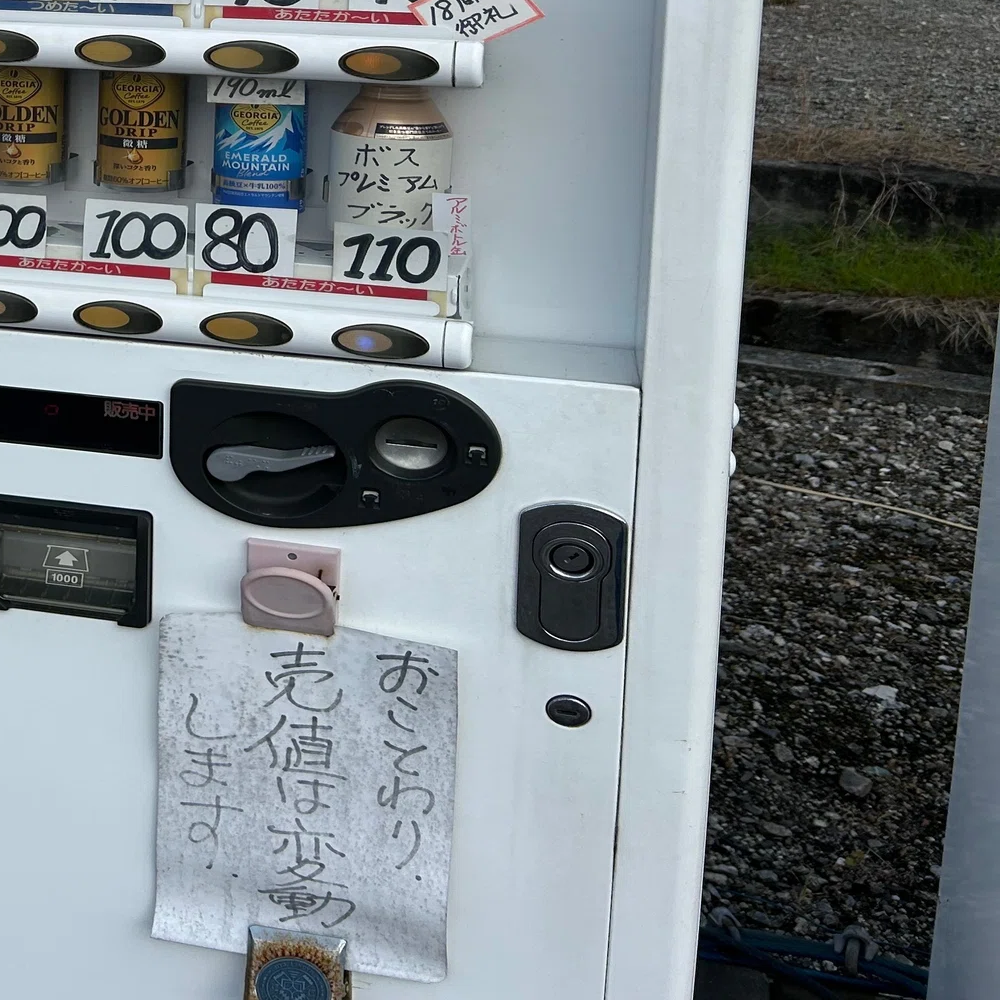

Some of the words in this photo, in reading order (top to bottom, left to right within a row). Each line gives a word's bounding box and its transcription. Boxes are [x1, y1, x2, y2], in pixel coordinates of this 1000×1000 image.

[2, 87, 27, 95] Coffee
[116, 84, 161, 93] GEORGIA
[212, 76, 298, 99] 190ml
[123, 92, 150, 100] Coffee
[100, 106, 181, 130] GOLDEN
[233, 111, 279, 120] GEORGIA
[241, 119, 269, 127] Coffee
[114, 126, 158, 138] DRIP
[122, 138, 148, 149] 微糖
[225, 151, 288, 163] EMERALD
[356, 144, 420, 167] ボス
[222, 160, 290, 171] MOUNTAIN
[235, 168, 270, 178] Blend
[338, 171, 438, 193] プレミアム
[347, 202, 433, 228] ブラック
[89, 209, 187, 260] 100
[201, 207, 280, 274] 80
[343, 233, 442, 284] 110
[103, 400, 156, 422] 販売中
[50, 572, 79, 584] 1000
[244, 641, 356, 929] 売値は変動
